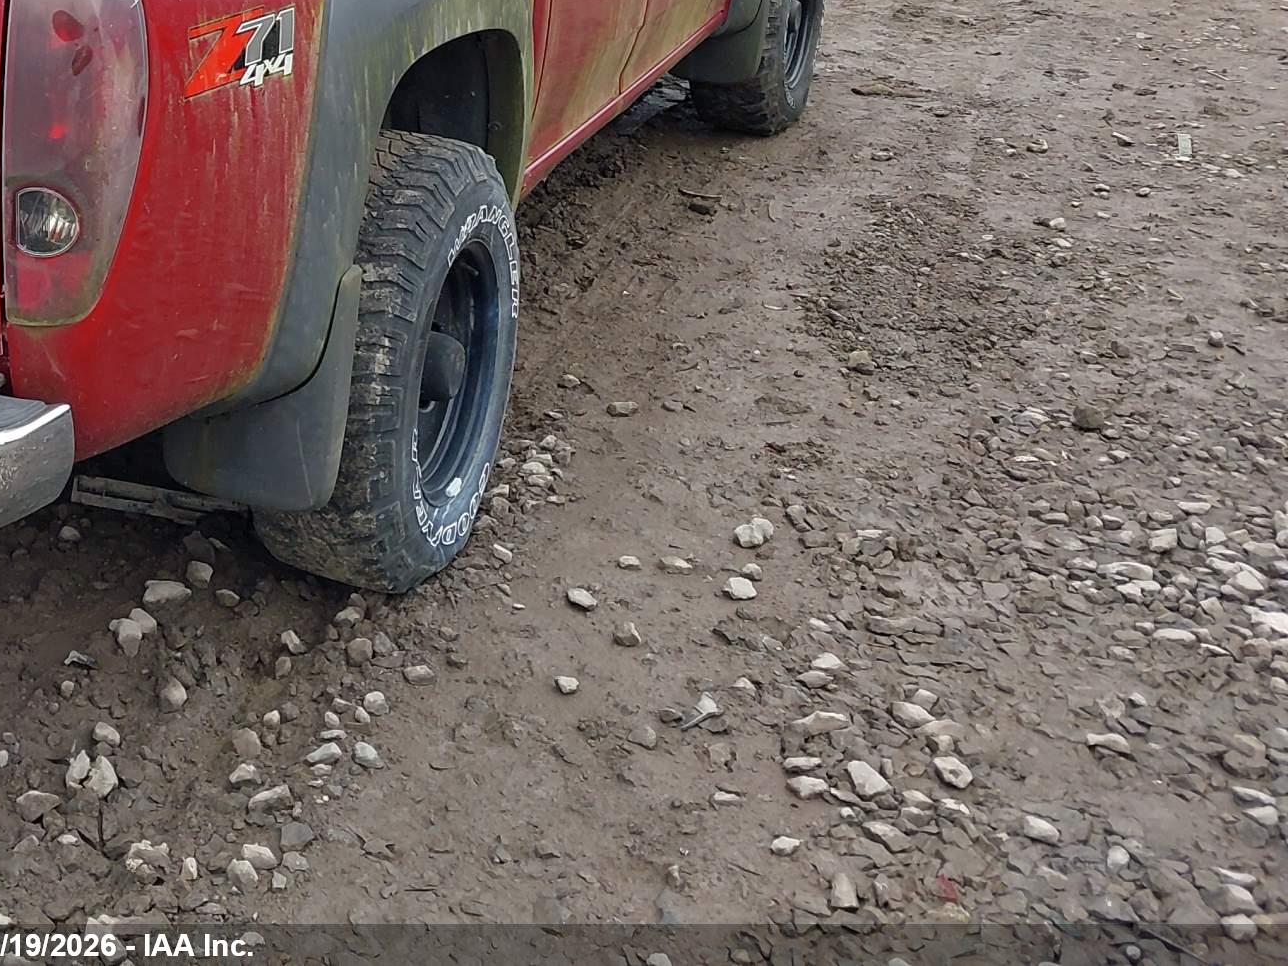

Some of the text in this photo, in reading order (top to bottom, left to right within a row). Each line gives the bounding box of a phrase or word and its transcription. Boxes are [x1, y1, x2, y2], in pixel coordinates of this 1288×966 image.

[183, 4, 296, 101] Z71
[447, 204, 520, 319] WRANGLER
[411, 428, 490, 547] GOODYEAR
